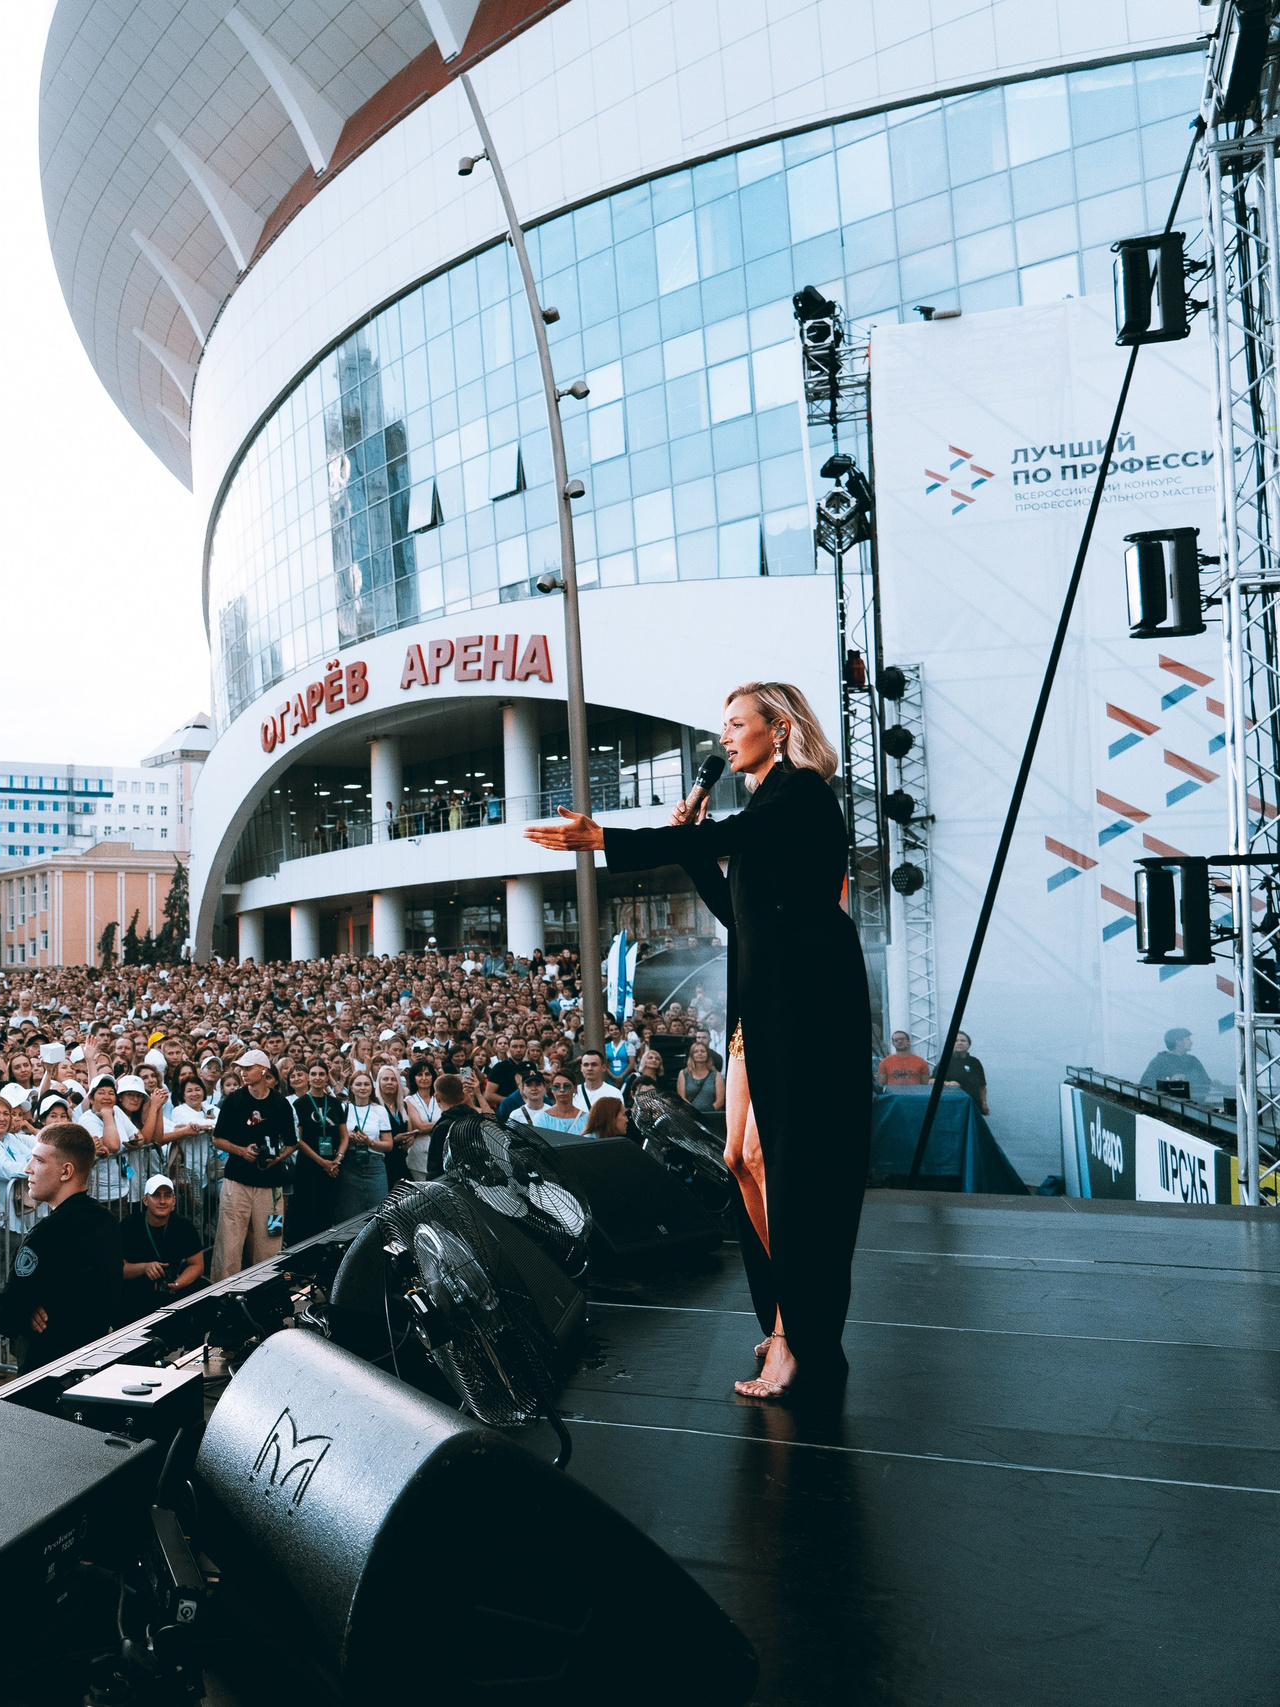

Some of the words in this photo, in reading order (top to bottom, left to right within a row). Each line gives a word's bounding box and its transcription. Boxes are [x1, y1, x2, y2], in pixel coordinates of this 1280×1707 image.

[1011, 432, 1135, 464] ЛУЧШИЙ
[1013, 467, 1051, 486] ПО
[1014, 481, 1120, 501] ВСЕРОССИЙСИЙ
[1124, 476, 1182, 489] КОНКУРС
[1015, 491, 1159, 512] ПРОФЕССИОАЛЬНОГО
[260, 659, 369, 753] ОГАРЁВ
[400, 634, 554, 690] АРЕНА
[1169, 1144, 1209, 1204] РСХБ
